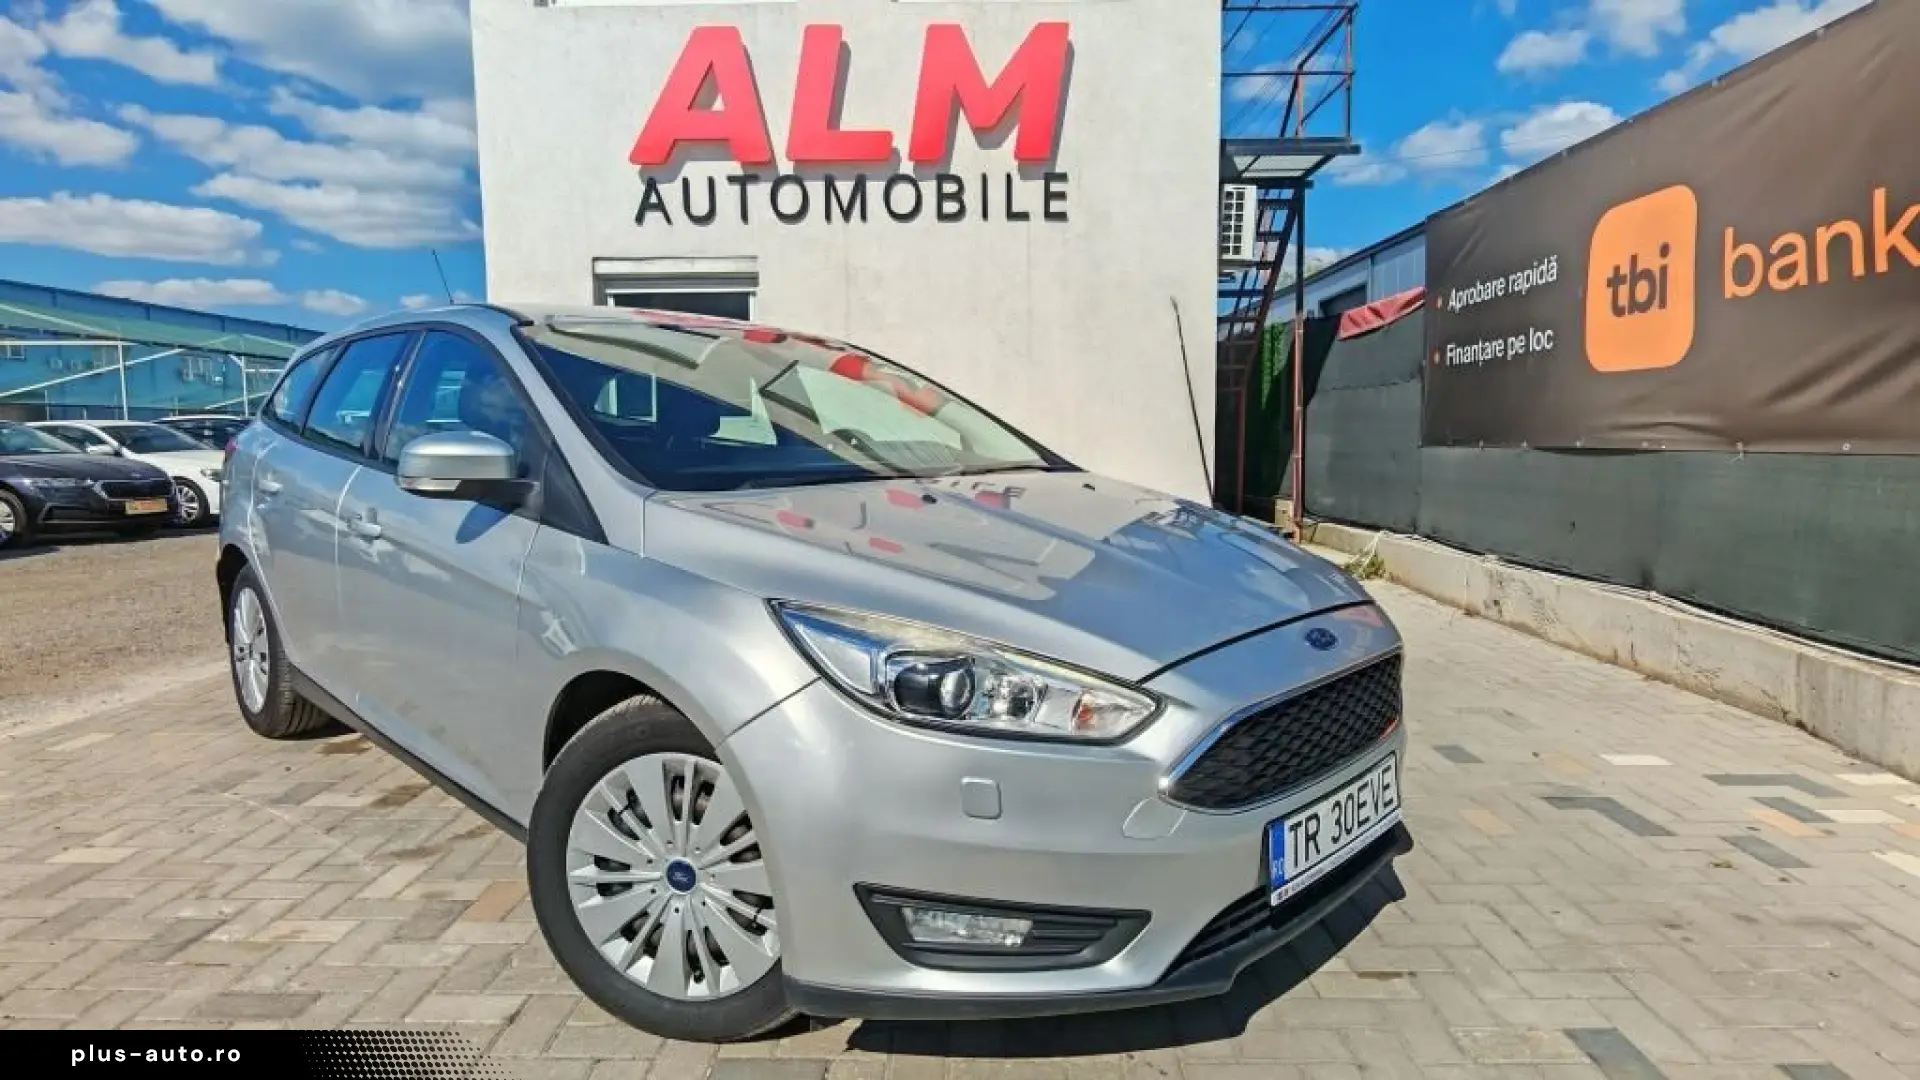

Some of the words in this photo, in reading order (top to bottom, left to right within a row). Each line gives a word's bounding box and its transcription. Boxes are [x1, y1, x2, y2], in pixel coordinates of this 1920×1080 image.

[629, 22, 1070, 165] ALM
[635, 172, 1069, 225] AUTOMOBILE
[1447, 277, 1506, 314] Aprobare
[1508, 254, 1558, 295] rapidă
[1606, 242, 1670, 318] tbi
[1724, 187, 1920, 298] bank
[1507, 334, 1526, 361] pe
[1529, 326, 1554, 352] loc
[1289, 813, 1321, 869] TR
[1331, 765, 1394, 844] 30EVE
